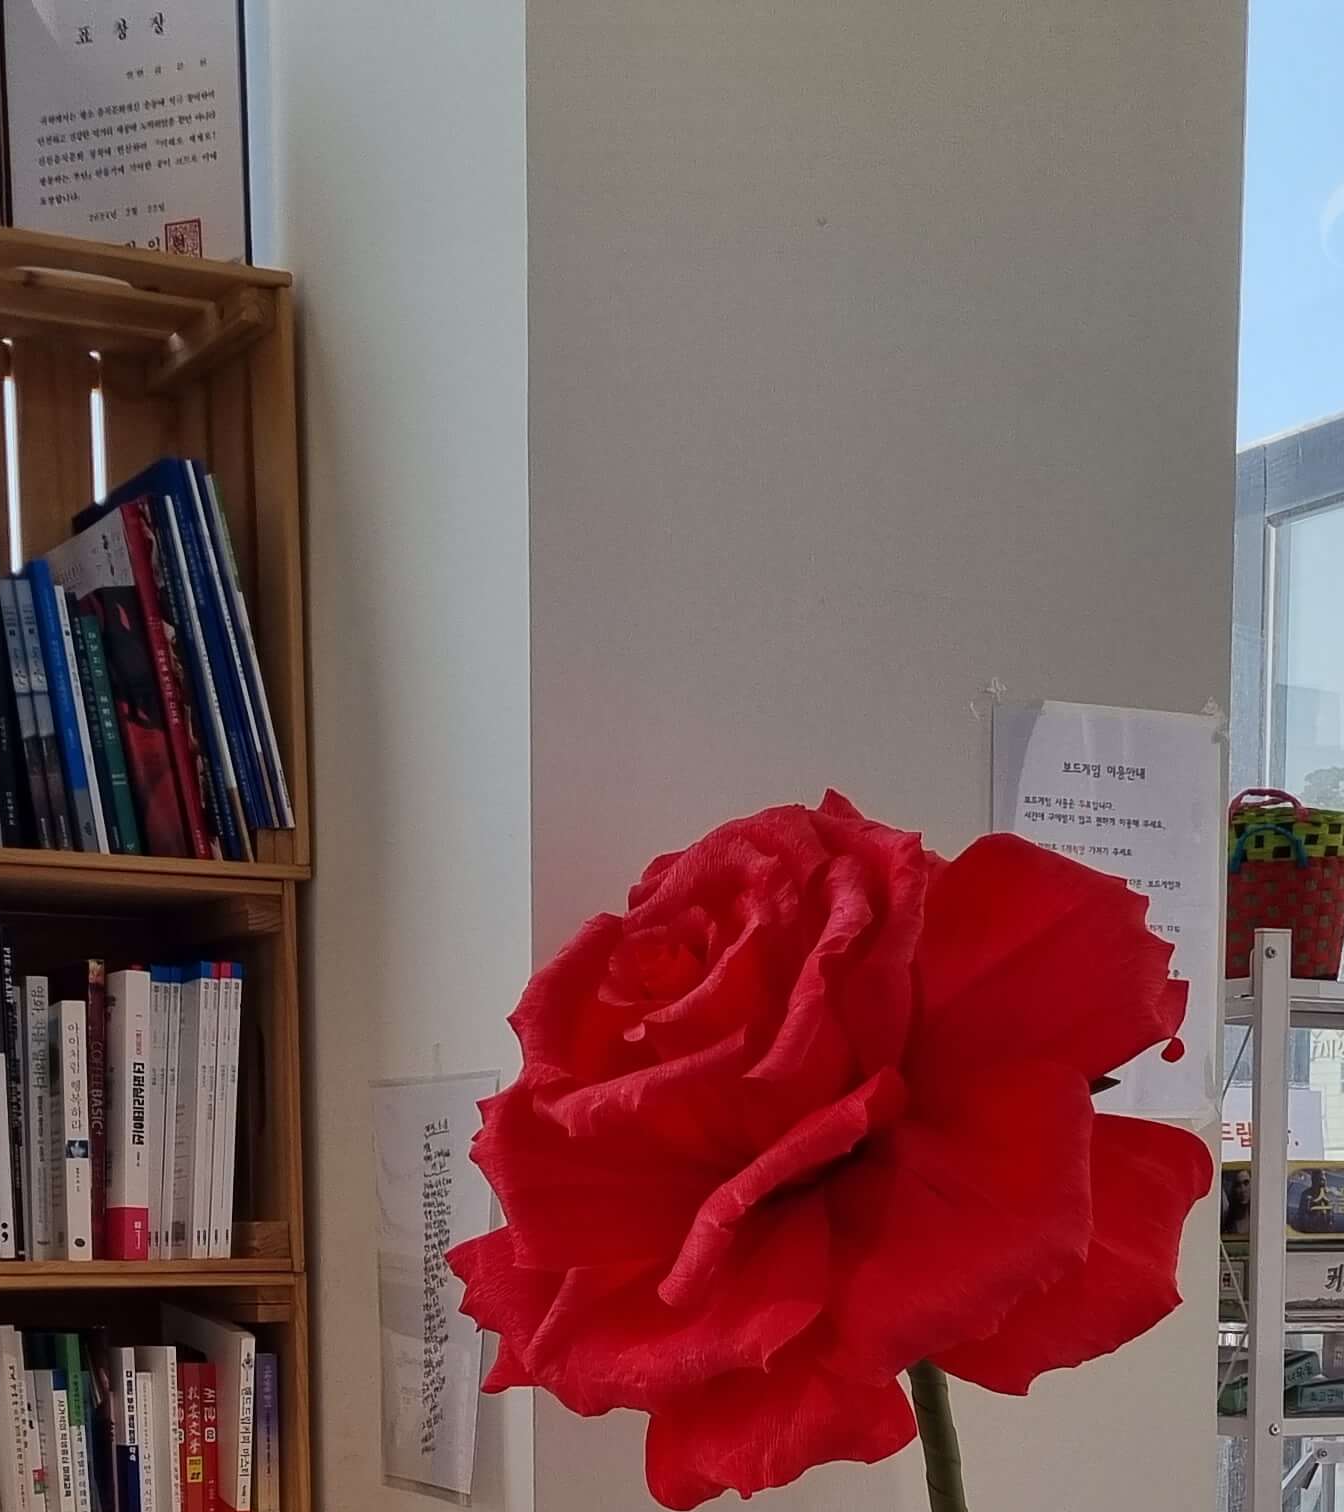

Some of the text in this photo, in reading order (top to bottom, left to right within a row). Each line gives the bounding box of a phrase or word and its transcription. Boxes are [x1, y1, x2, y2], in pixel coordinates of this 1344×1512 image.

[1062, 761, 1146, 781] 보드게임 이용안내
[131, 1076, 146, 1146] 퍼실리테이션
[239, 1447, 251, 1478] 마스터
